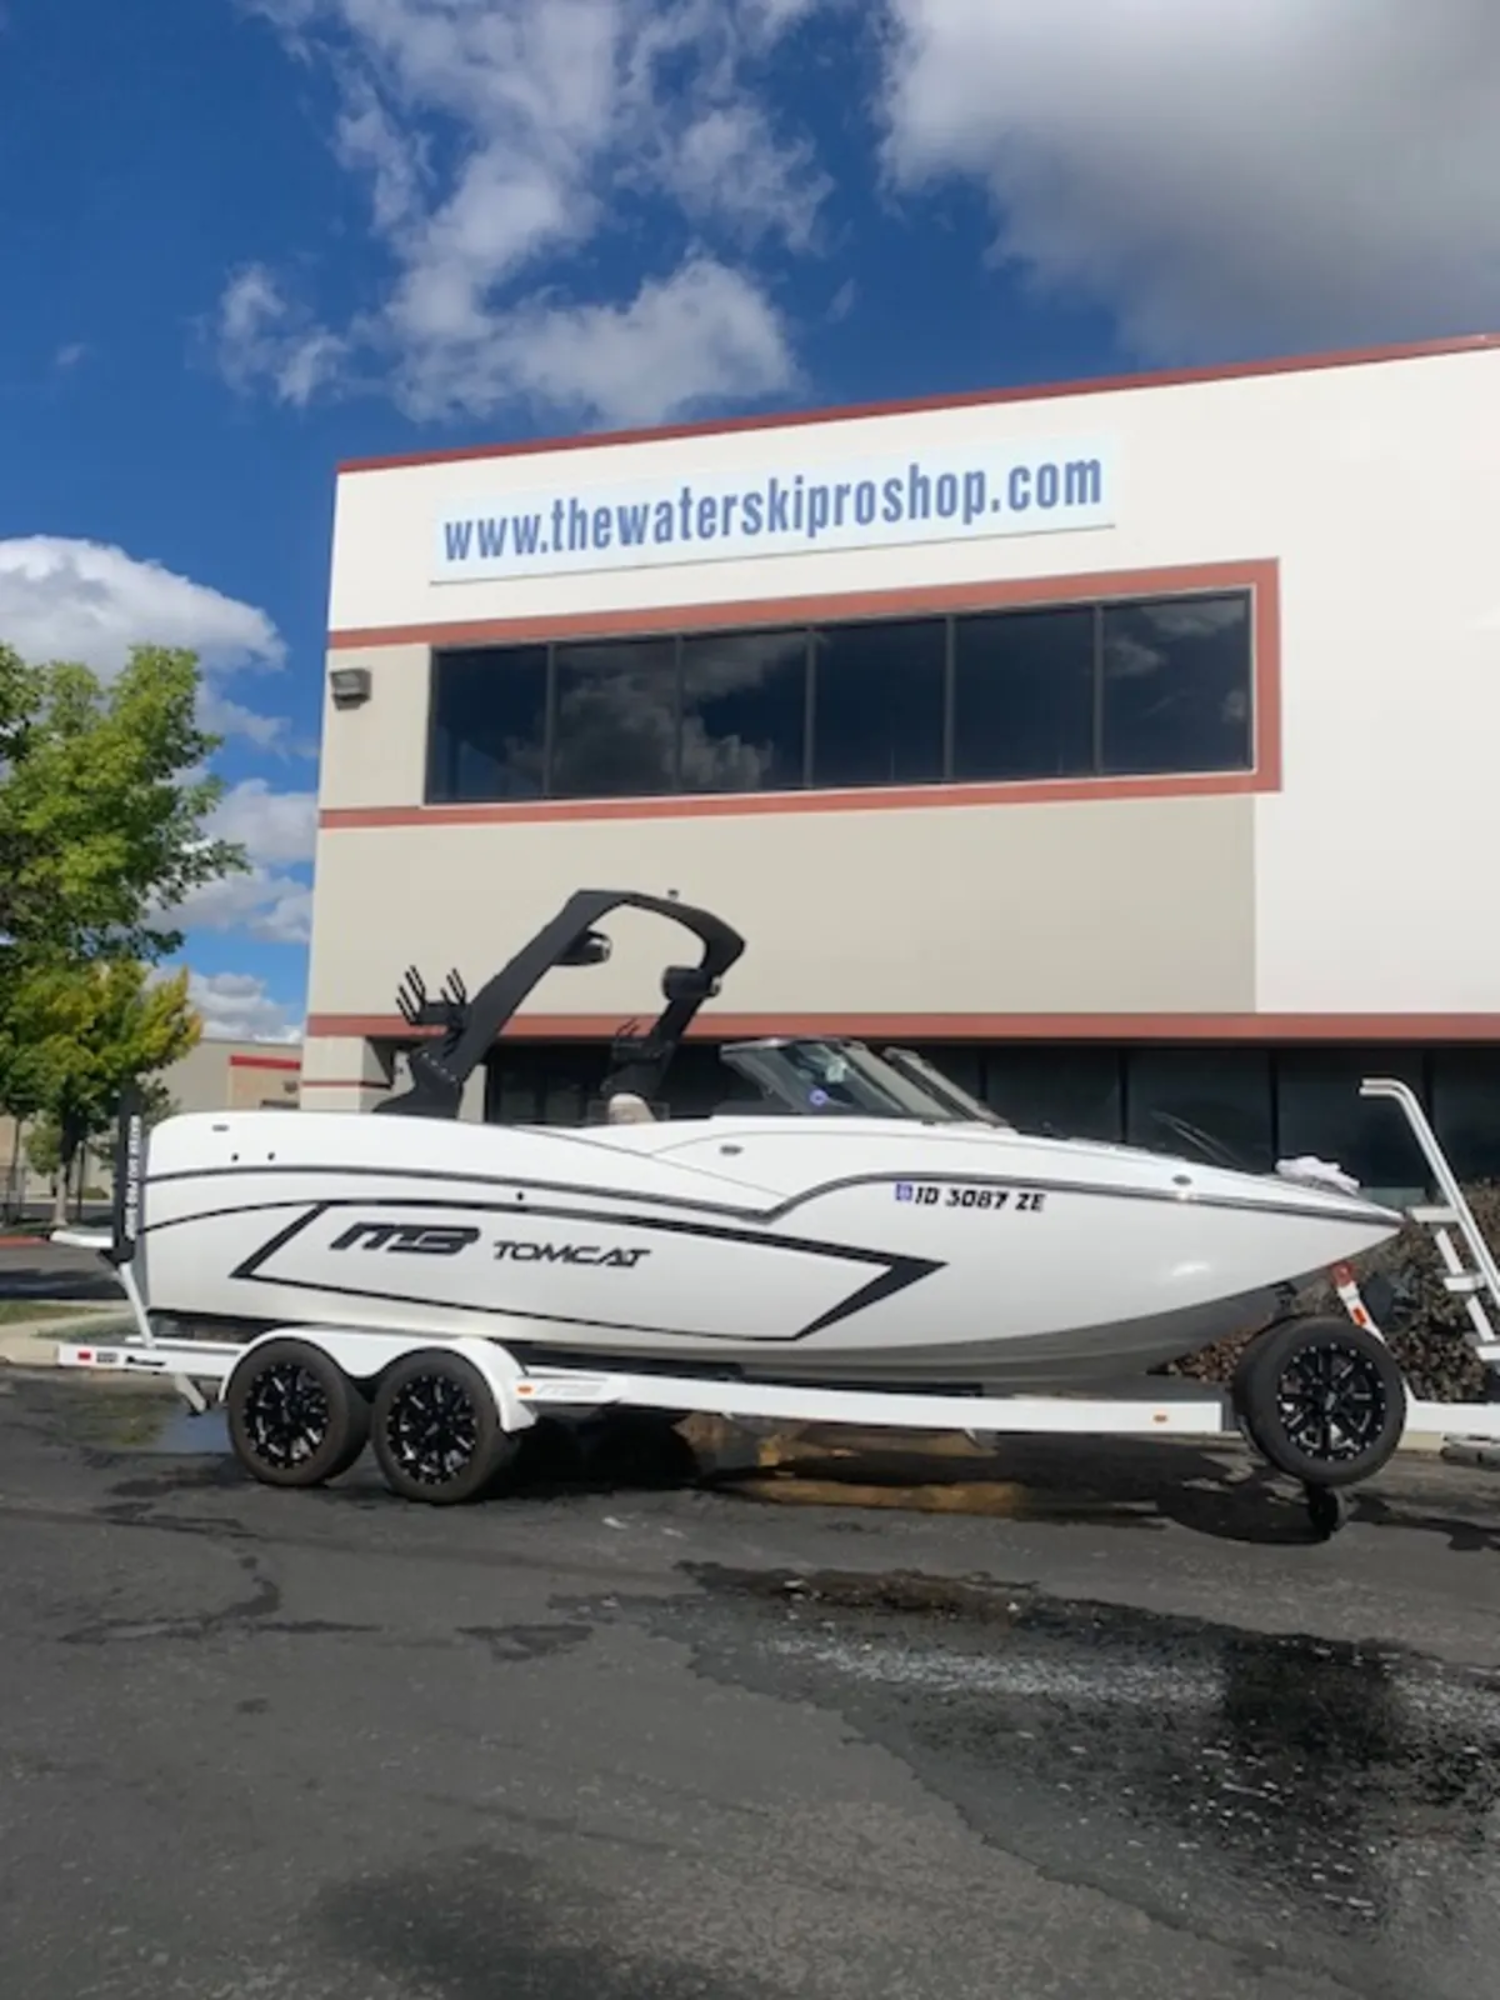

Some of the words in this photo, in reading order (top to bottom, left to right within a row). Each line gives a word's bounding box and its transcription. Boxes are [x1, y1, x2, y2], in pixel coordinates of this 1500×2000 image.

[445, 457, 1102, 561] www.thewaterskiproshop.com
[915, 1186, 940, 1205] ID
[944, 1188, 1010, 1210] 3087
[1015, 1193, 1046, 1212] ZE
[493, 1240, 653, 1268] TOMCAT
